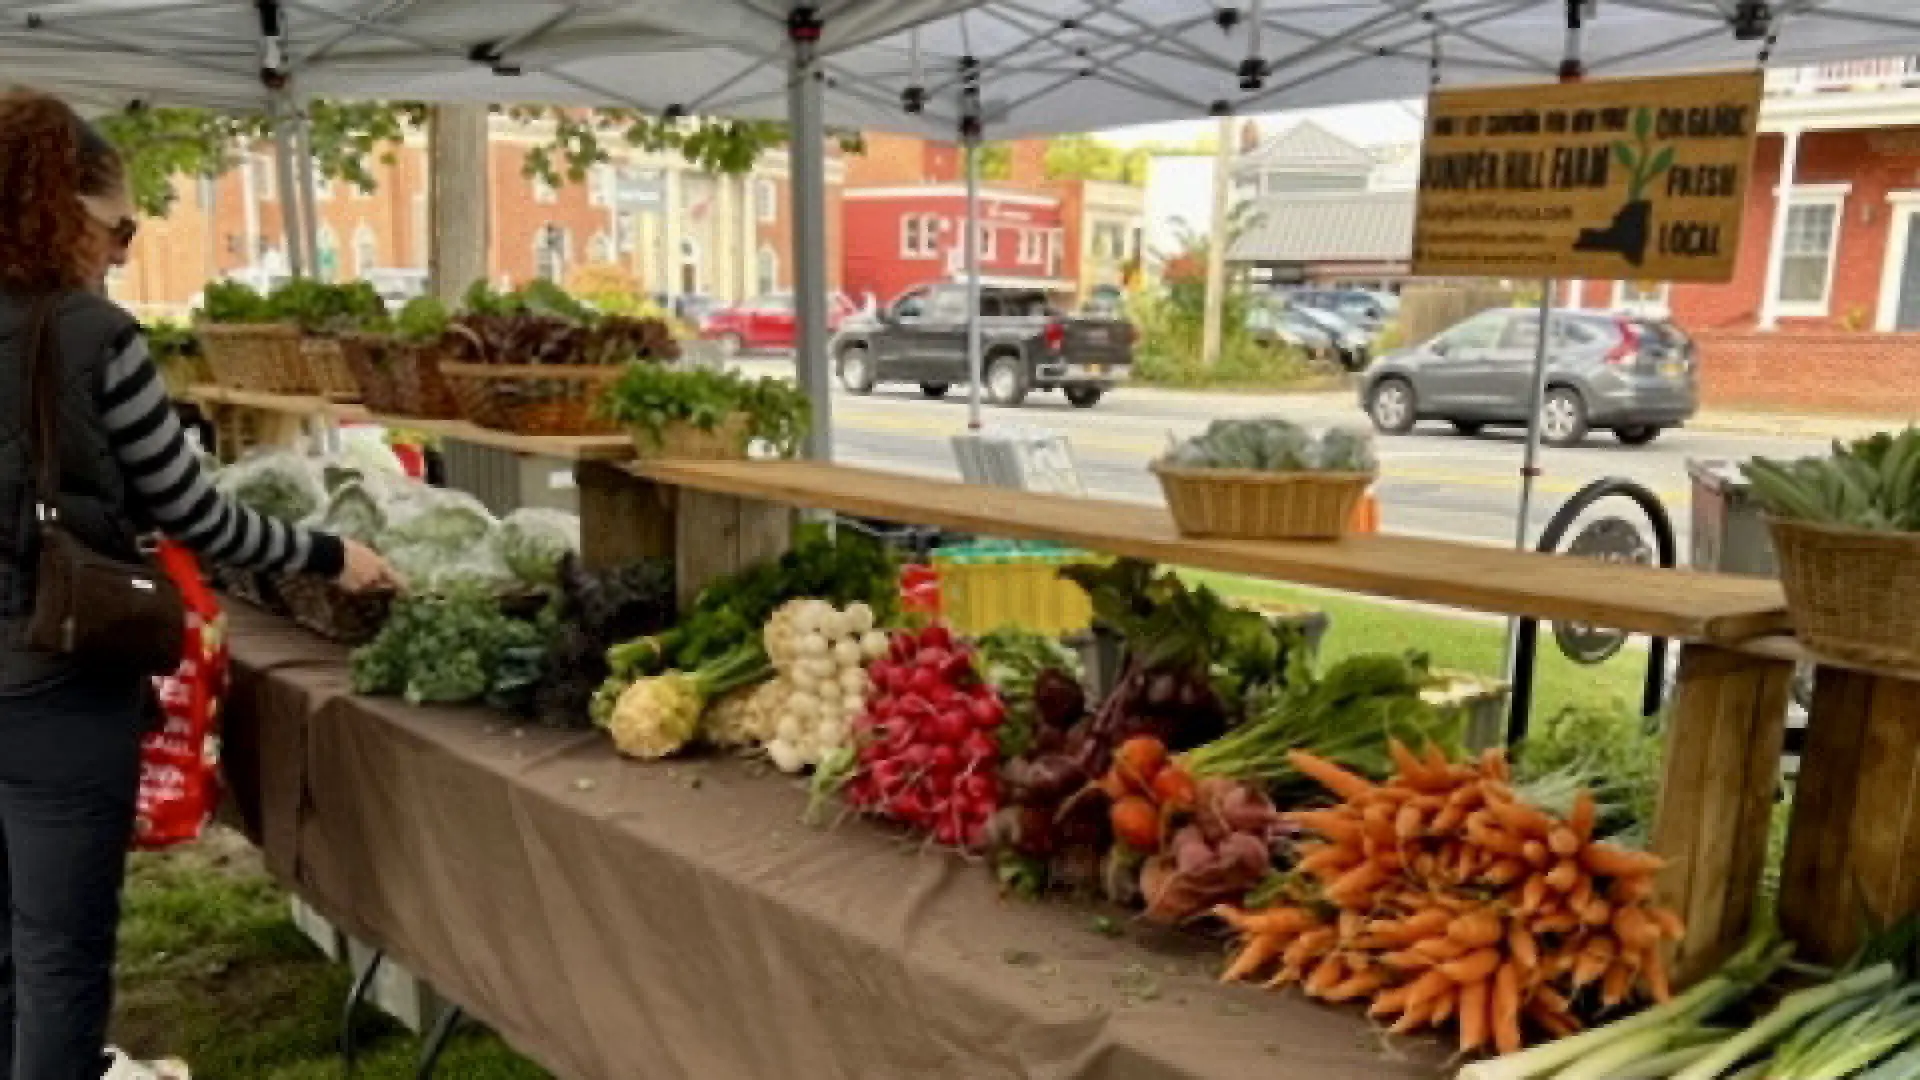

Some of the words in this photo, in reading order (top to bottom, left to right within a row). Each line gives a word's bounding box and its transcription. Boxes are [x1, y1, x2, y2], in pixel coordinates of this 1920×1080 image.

[1656, 106, 1748, 137] ORGANIC
[1420, 151, 1499, 190] JUNIPER
[1503, 150, 1545, 189] HILL
[1550, 147, 1610, 189] FARM
[1667, 163, 1737, 197] FRESH
[1659, 222, 1721, 256] LOCAL
